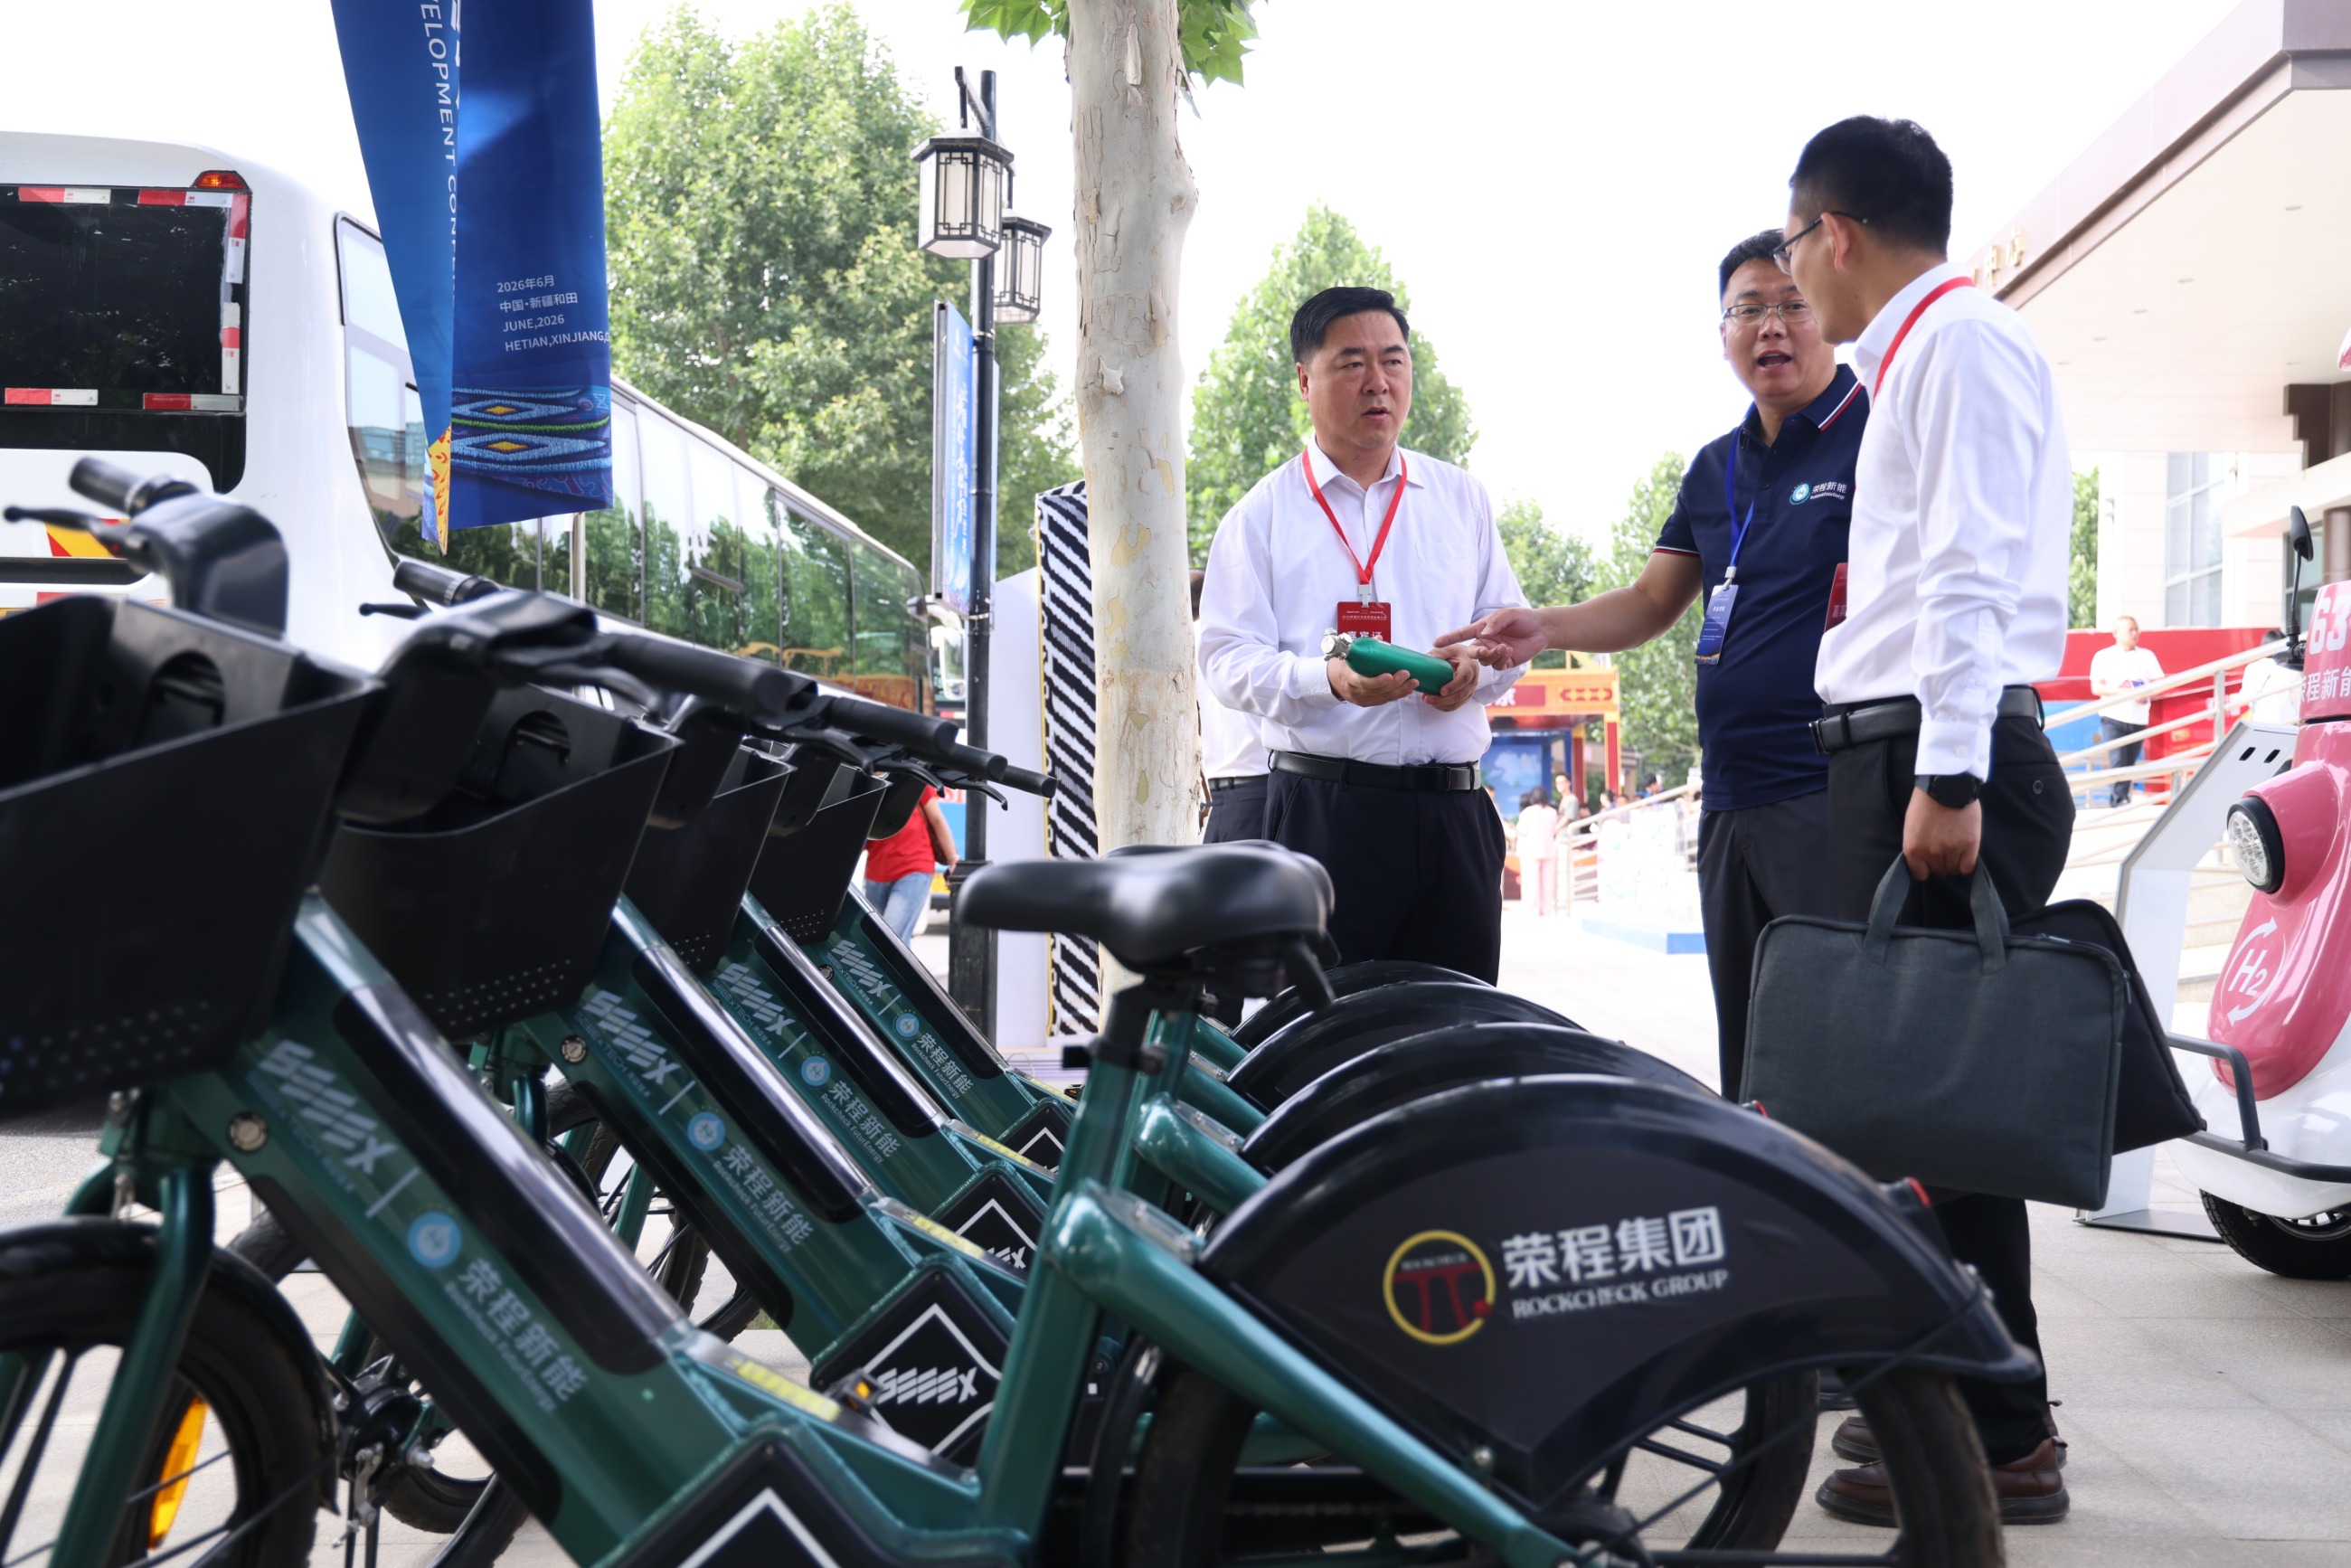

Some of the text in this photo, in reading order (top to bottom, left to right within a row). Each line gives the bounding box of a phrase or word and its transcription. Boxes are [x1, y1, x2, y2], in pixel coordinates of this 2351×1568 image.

[420, 0, 456, 166] ELOPMENT
[496, 275, 554, 293] 2026年6月
[500, 292, 578, 313] 中国·新疆和田
[503, 315, 565, 332] JUNE,2026
[911, 1044, 935, 1070] Rockcheck
[917, 1032, 974, 1094] 荣程新能
[821, 1093, 852, 1128] Rockcheck
[828, 1080, 901, 1157] 荣程新能
[723, 1144, 814, 1245] 荣程新能
[1500, 1205, 1725, 1289] 荣程集团
[1511, 1268, 1729, 1319] ROCKCHECK GROUP
[457, 1256, 590, 1406] 荣程新能
